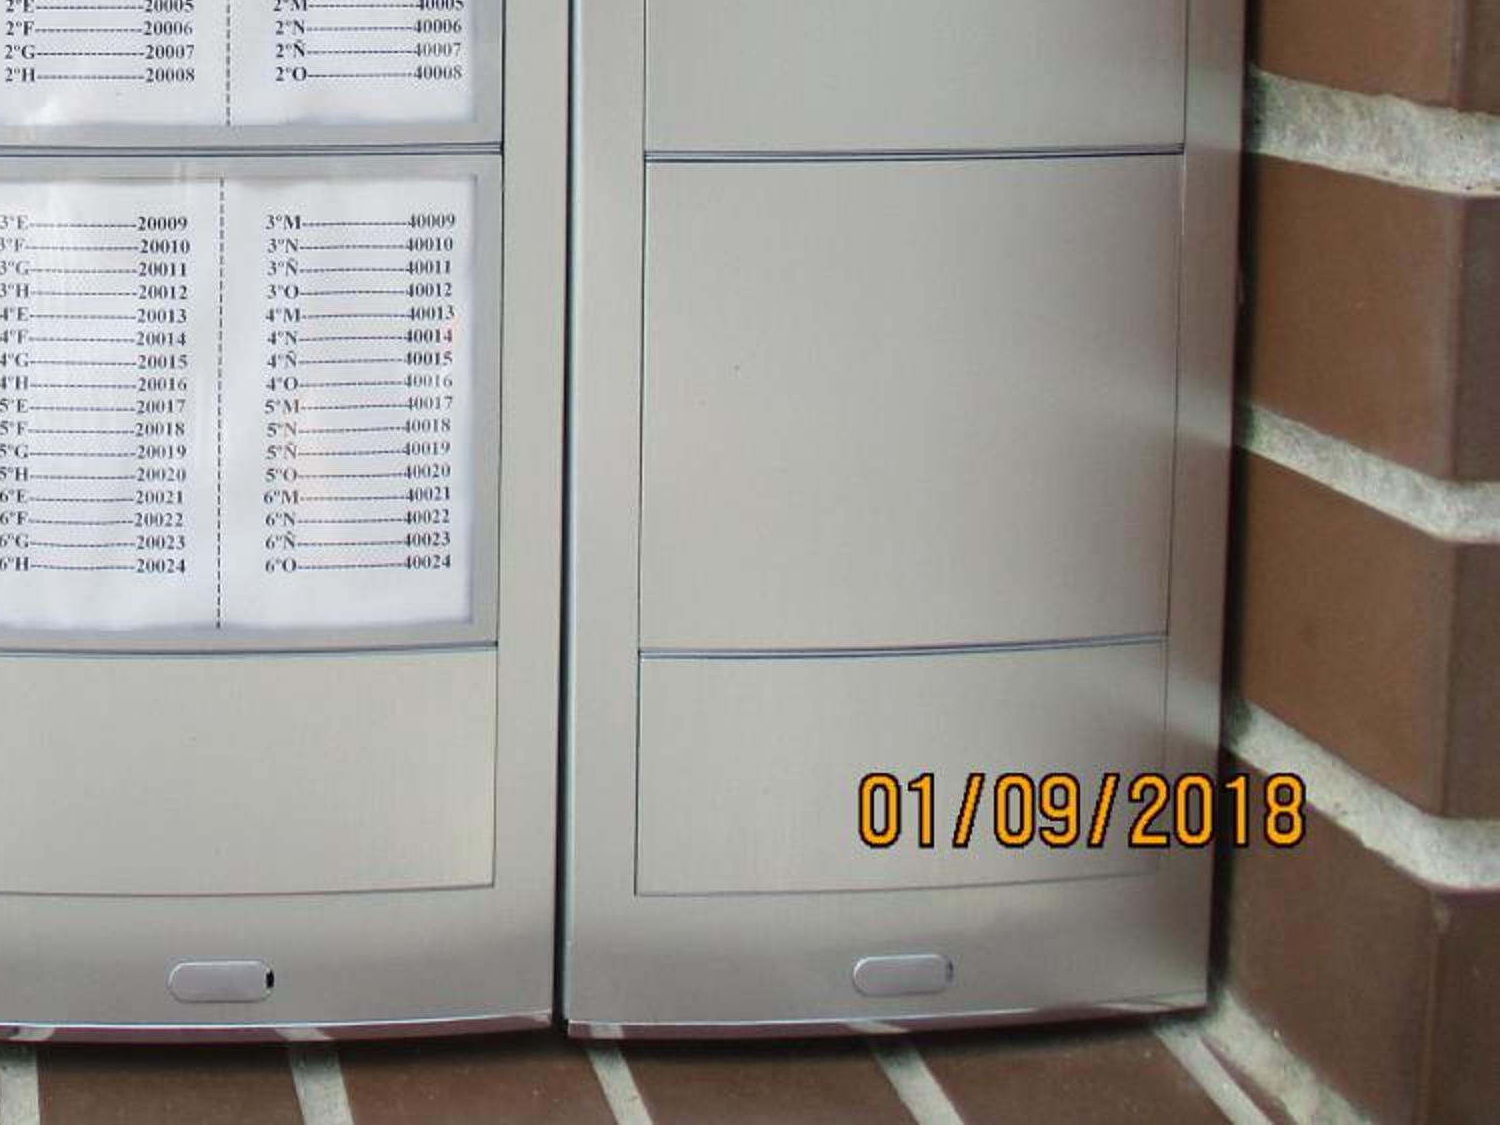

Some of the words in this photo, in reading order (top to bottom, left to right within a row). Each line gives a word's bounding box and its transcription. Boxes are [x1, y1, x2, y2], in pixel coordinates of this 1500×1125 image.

[142, 20, 194, 37] 20006
[411, 18, 463, 35] 40006
[143, 43, 195, 60] 20007
[144, 66, 196, 83] 20008
[137, 215, 189, 232] 20009
[405, 213, 457, 230] 40009
[138, 238, 190, 255] 20010
[402, 236, 454, 253] 40010
[136, 261, 188, 278] 20011
[400, 259, 452, 276] 40011
[136, 284, 188, 301] 20012
[401, 281, 453, 298] 40012
[135, 307, 187, 324] 20013
[404, 305, 456, 322] 40013
[135, 330, 187, 347] 20014
[401, 327, 453, 344] 40014
[137, 353, 189, 370] 20015
[401, 350, 453, 367] 40015
[137, 376, 189, 393] 20016
[401, 372, 453, 389] 40016
[137, 398, 189, 415] 20017
[402, 394, 454, 411] 40017
[133, 421, 185, 438] 20018
[400, 417, 452, 434] 40018
[135, 443, 187, 460] 20019
[399, 440, 451, 457] 40019
[135, 466, 187, 483] 20020
[400, 462, 452, 479] 40020
[132, 489, 184, 506] 20021
[399, 485, 451, 502] 40021
[133, 511, 185, 528] 20022
[398, 508, 450, 525] 40022
[134, 534, 186, 551] 20023
[399, 531, 451, 548] 40023
[134, 557, 186, 574] 20024
[400, 553, 452, 570] 40024
